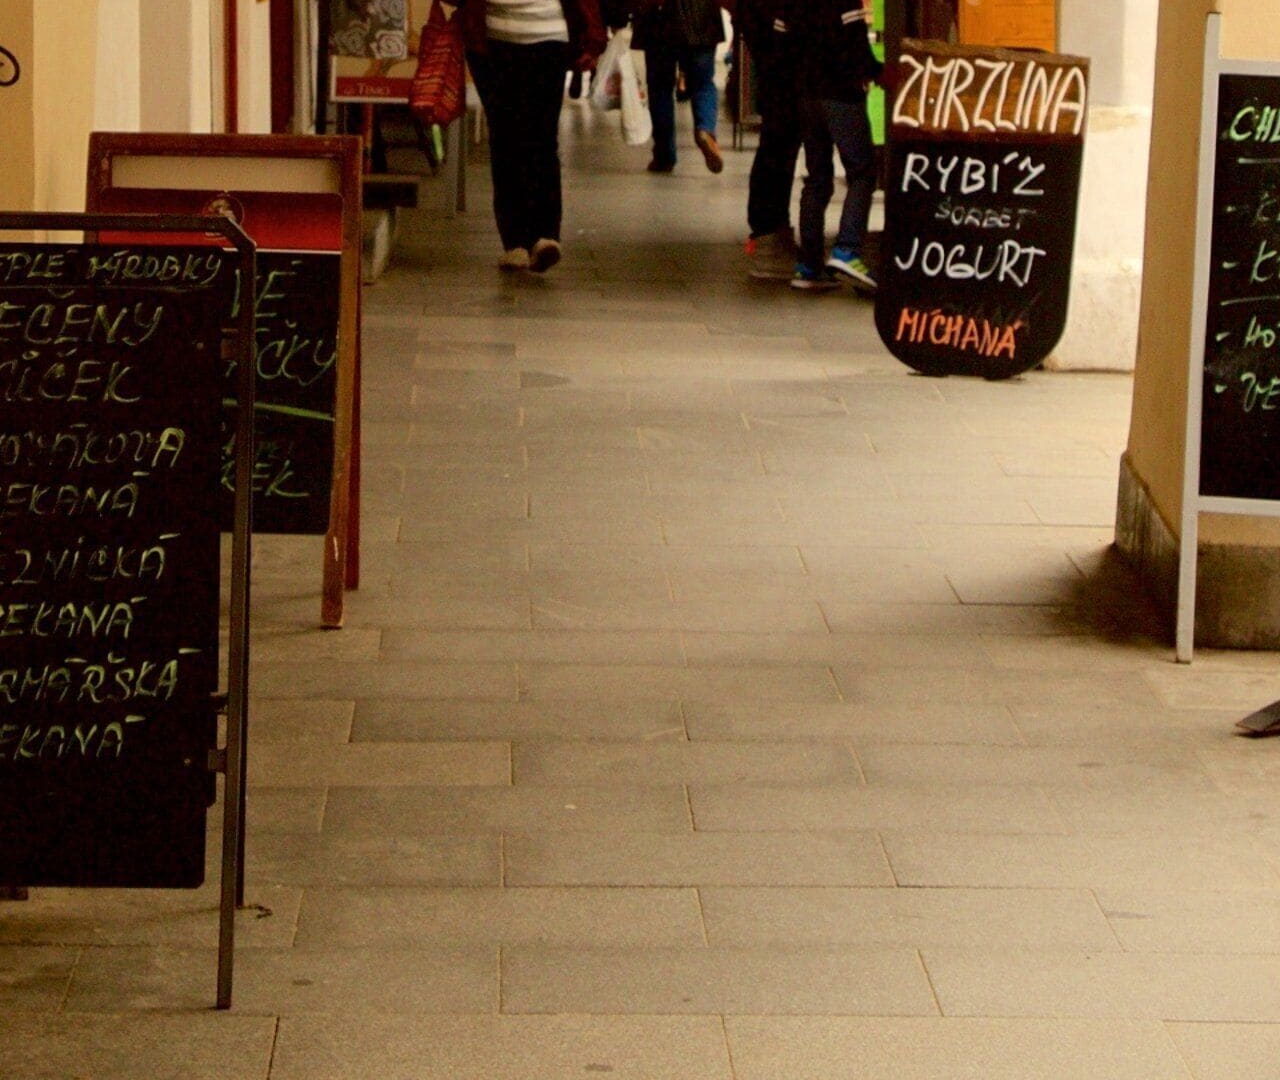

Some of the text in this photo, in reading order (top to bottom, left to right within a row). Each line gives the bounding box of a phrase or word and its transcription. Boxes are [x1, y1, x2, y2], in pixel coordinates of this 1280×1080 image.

[892, 54, 1087, 136] ZMRZLINA
[901, 151, 1046, 195] RYBÍZ
[894, 237, 1047, 288] JOGURT
[895, 307, 1023, 360] MÍCHANÁ
